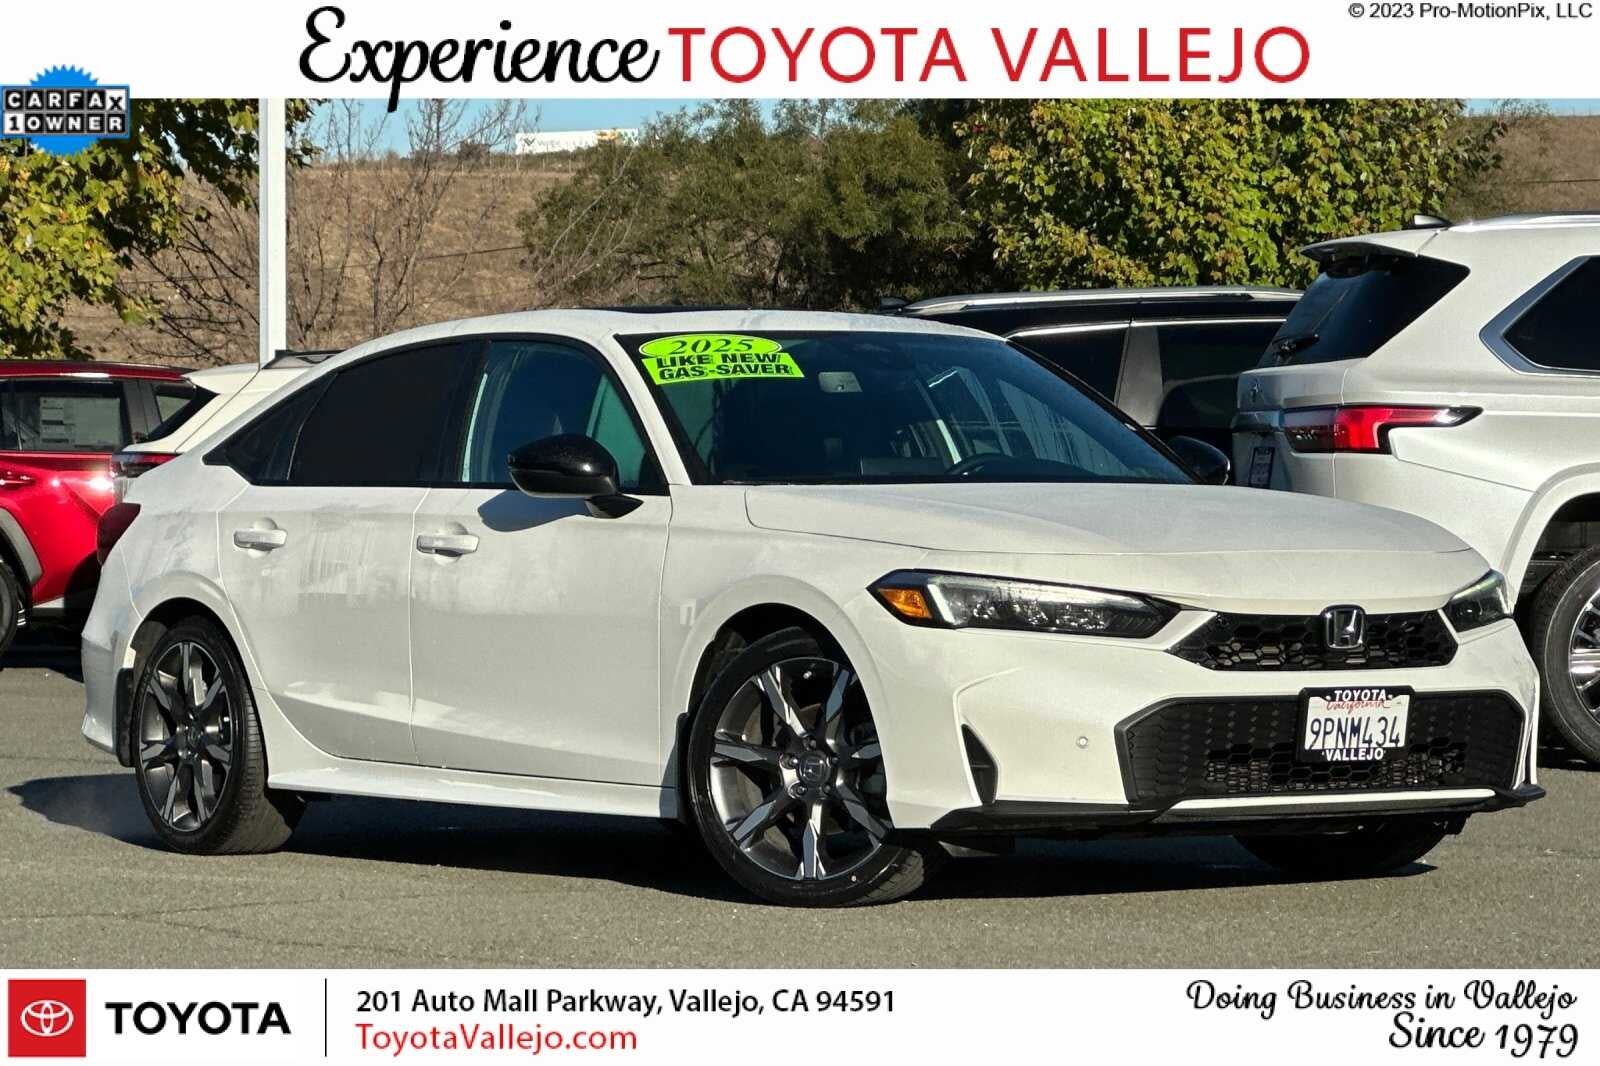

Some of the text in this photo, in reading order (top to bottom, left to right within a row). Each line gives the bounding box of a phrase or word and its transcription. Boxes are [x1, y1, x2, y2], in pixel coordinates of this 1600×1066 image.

[671, 339, 753, 353] 2025
[656, 352, 781, 368] LIKE NEW
[659, 364, 793, 379] GAS-SAVER
[1334, 689, 1386, 701] TOYOTA
[1309, 716, 1400, 749] 9PNM434
[1325, 748, 1385, 762] VALLEJO
